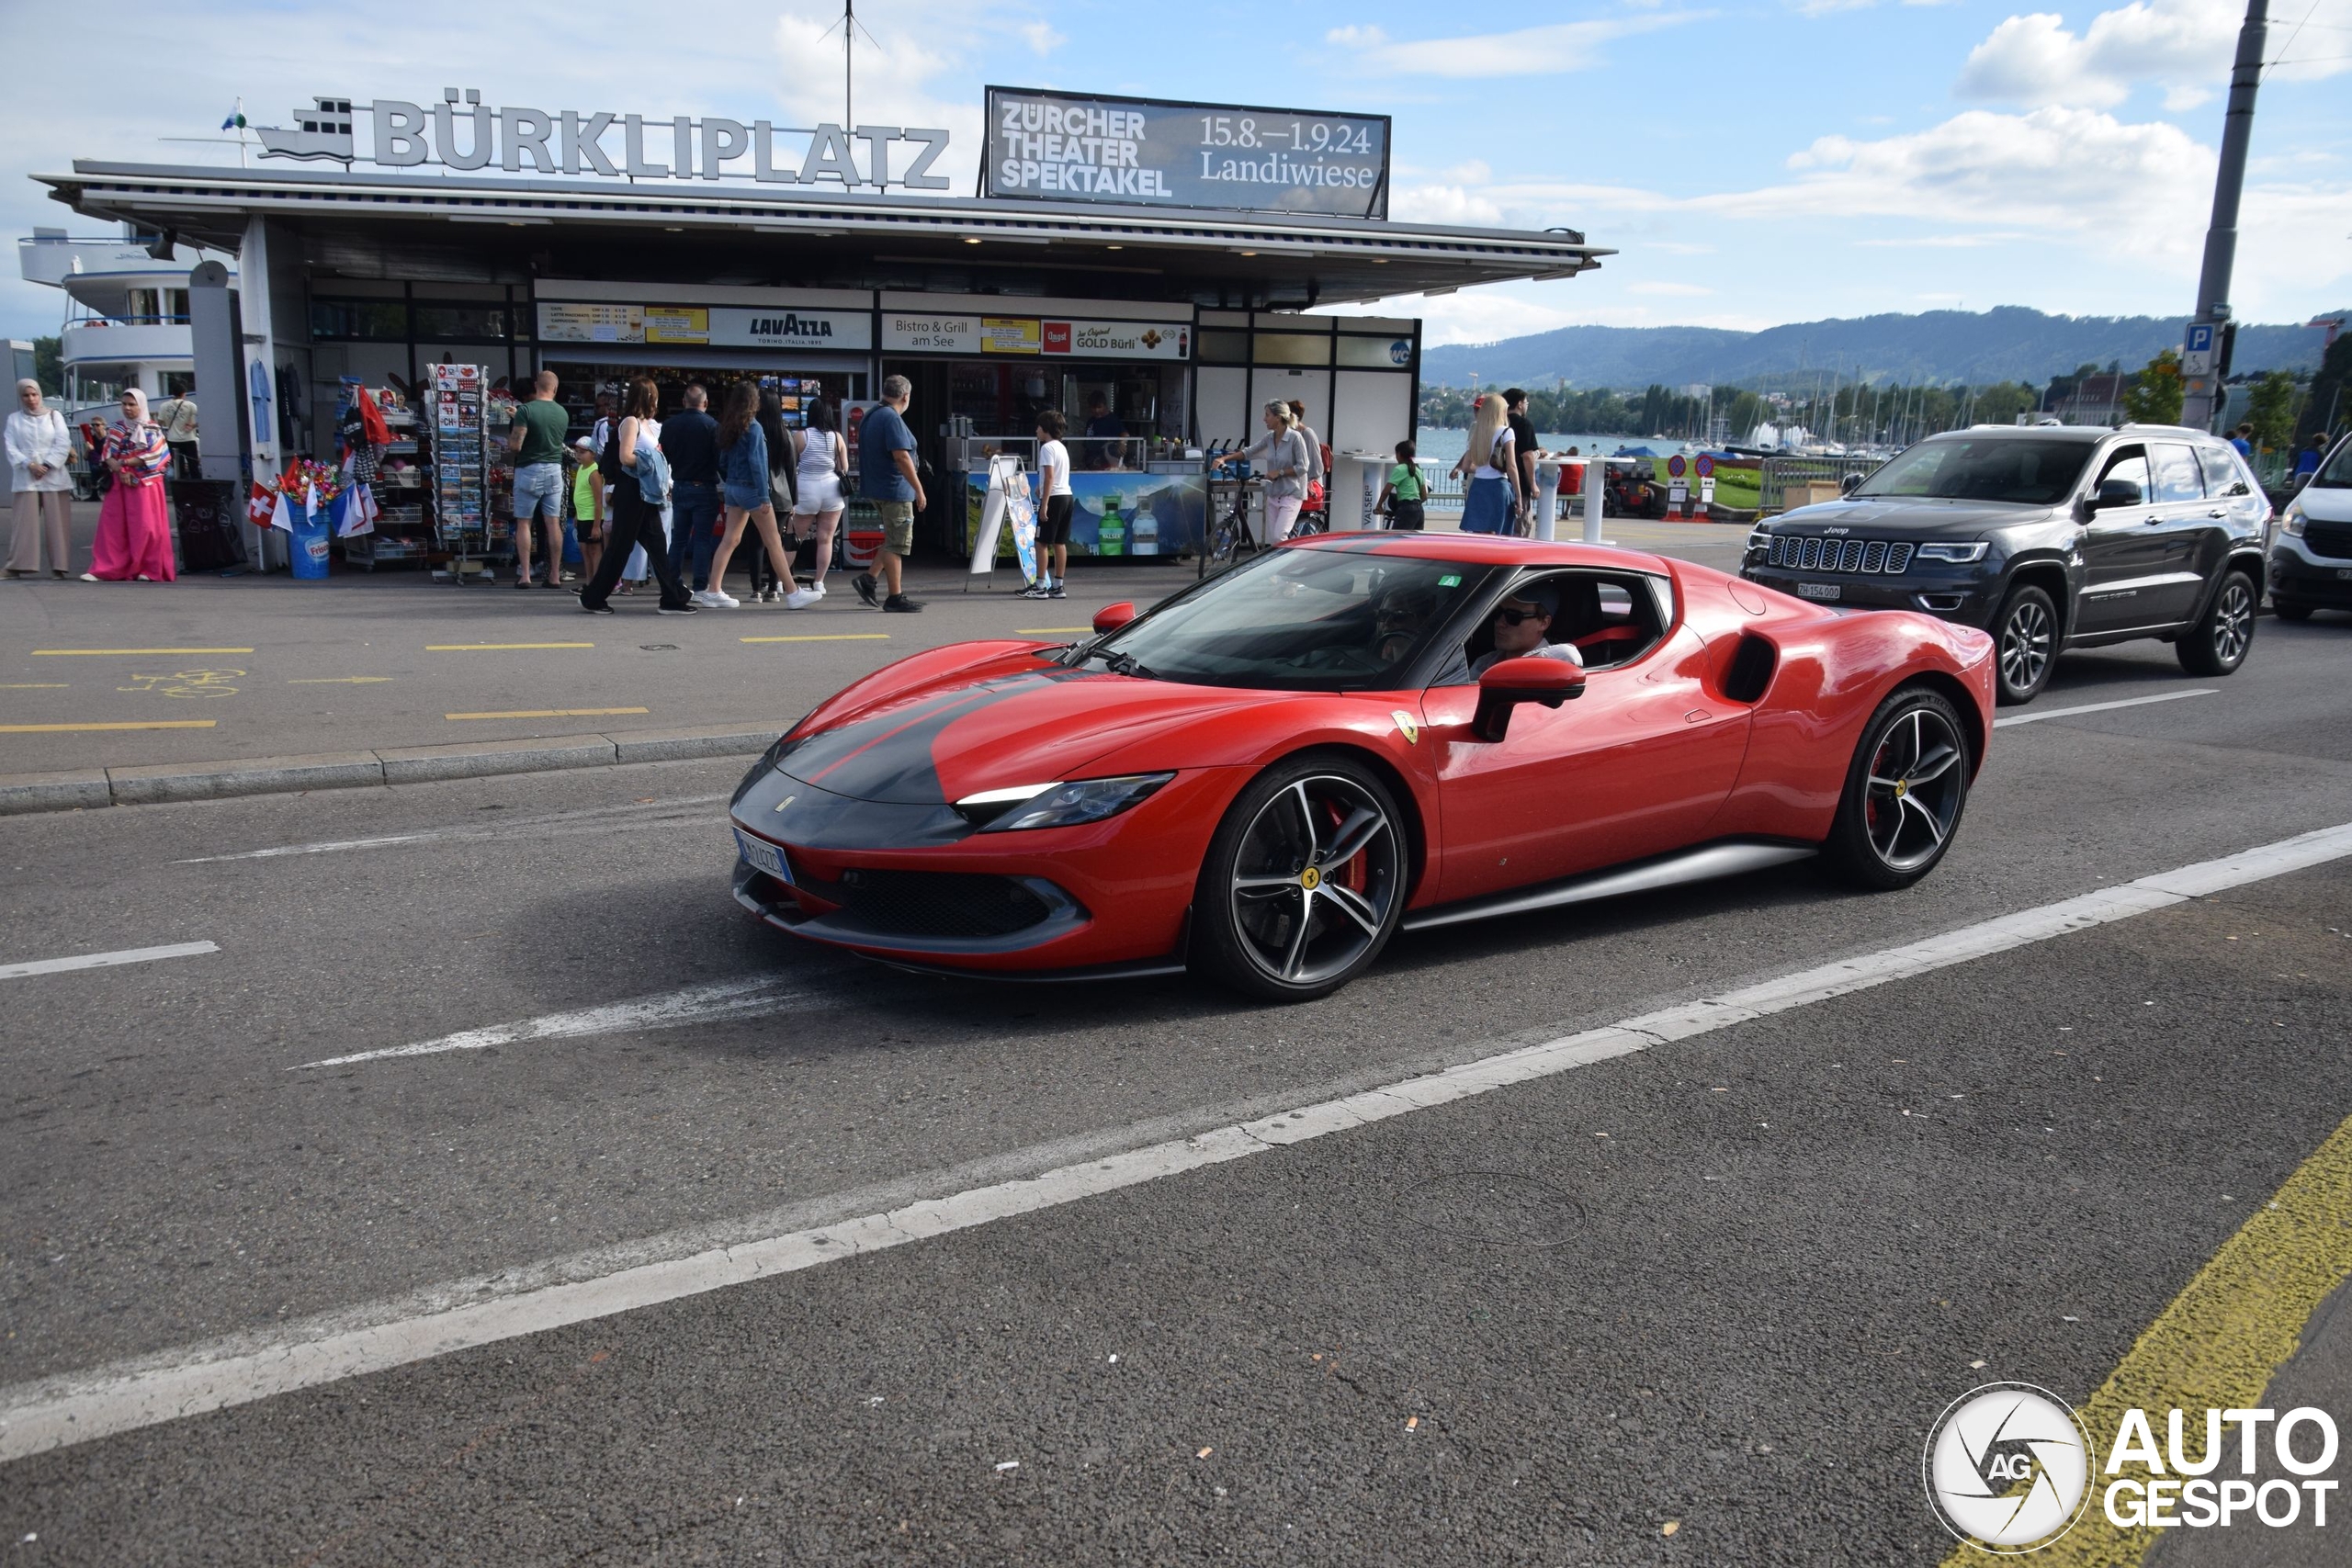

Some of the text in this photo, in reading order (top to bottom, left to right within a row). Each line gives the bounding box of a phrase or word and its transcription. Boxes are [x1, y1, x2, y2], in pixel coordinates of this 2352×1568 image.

[1001, 101, 1147, 141] ZÜRCHER
[372, 87, 950, 190] BÜRKLIPLATZ
[1001, 129, 1139, 169] THEATER
[1001, 160, 1173, 197] SPEKTAKEL
[1200, 151, 1374, 189] Landiwiese
[750, 313, 832, 337] LAVAZZA
[896, 320, 967, 333] Bistro & Grill
[911, 335, 955, 346] am See
[1077, 337, 1108, 349] GOLD
[2193, 329, 2208, 349] P
[1389, 349, 1410, 362] WC
[1363, 490, 1374, 526] VALSER
[1824, 526, 1849, 536] Jeep
